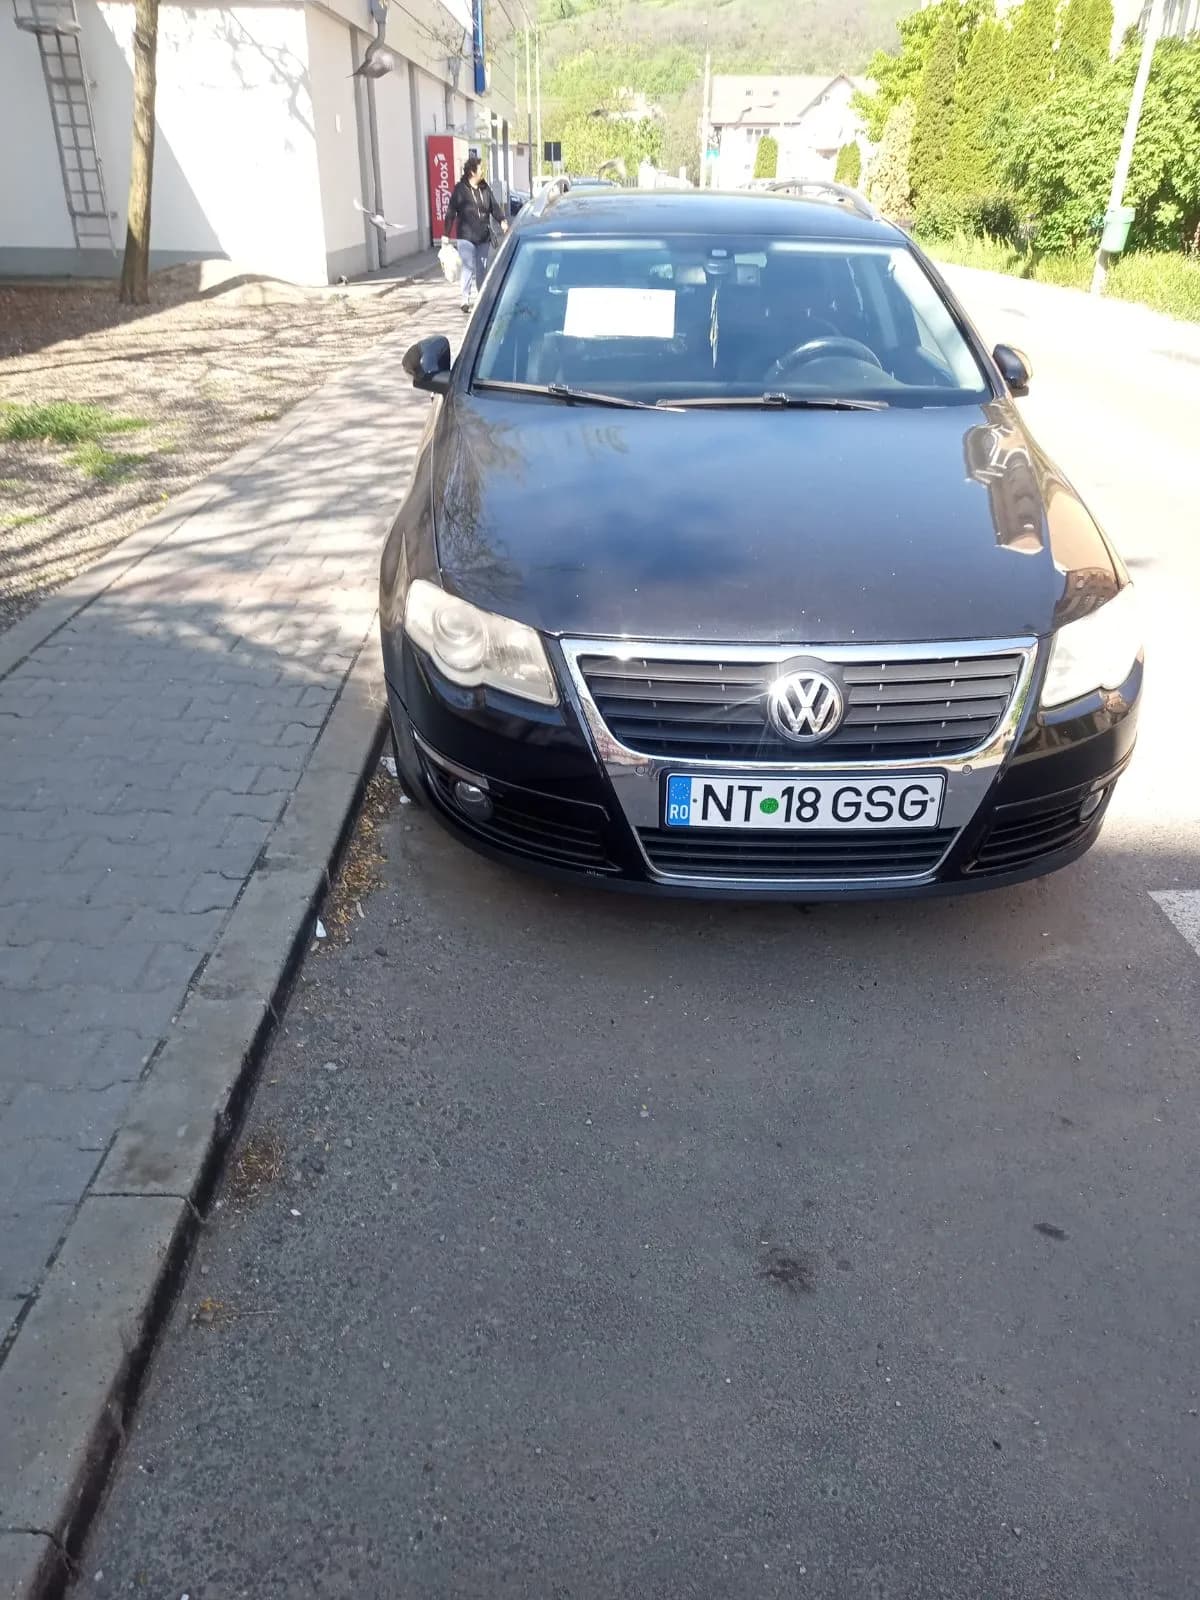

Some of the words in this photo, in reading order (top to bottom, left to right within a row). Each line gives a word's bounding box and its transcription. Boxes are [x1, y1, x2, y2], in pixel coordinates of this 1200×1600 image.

[770, 671, 840, 740] VW
[670, 803, 689, 819] RO
[701, 784, 762, 822] NT
[780, 785, 821, 823] 18
[831, 784, 929, 822] GSG
